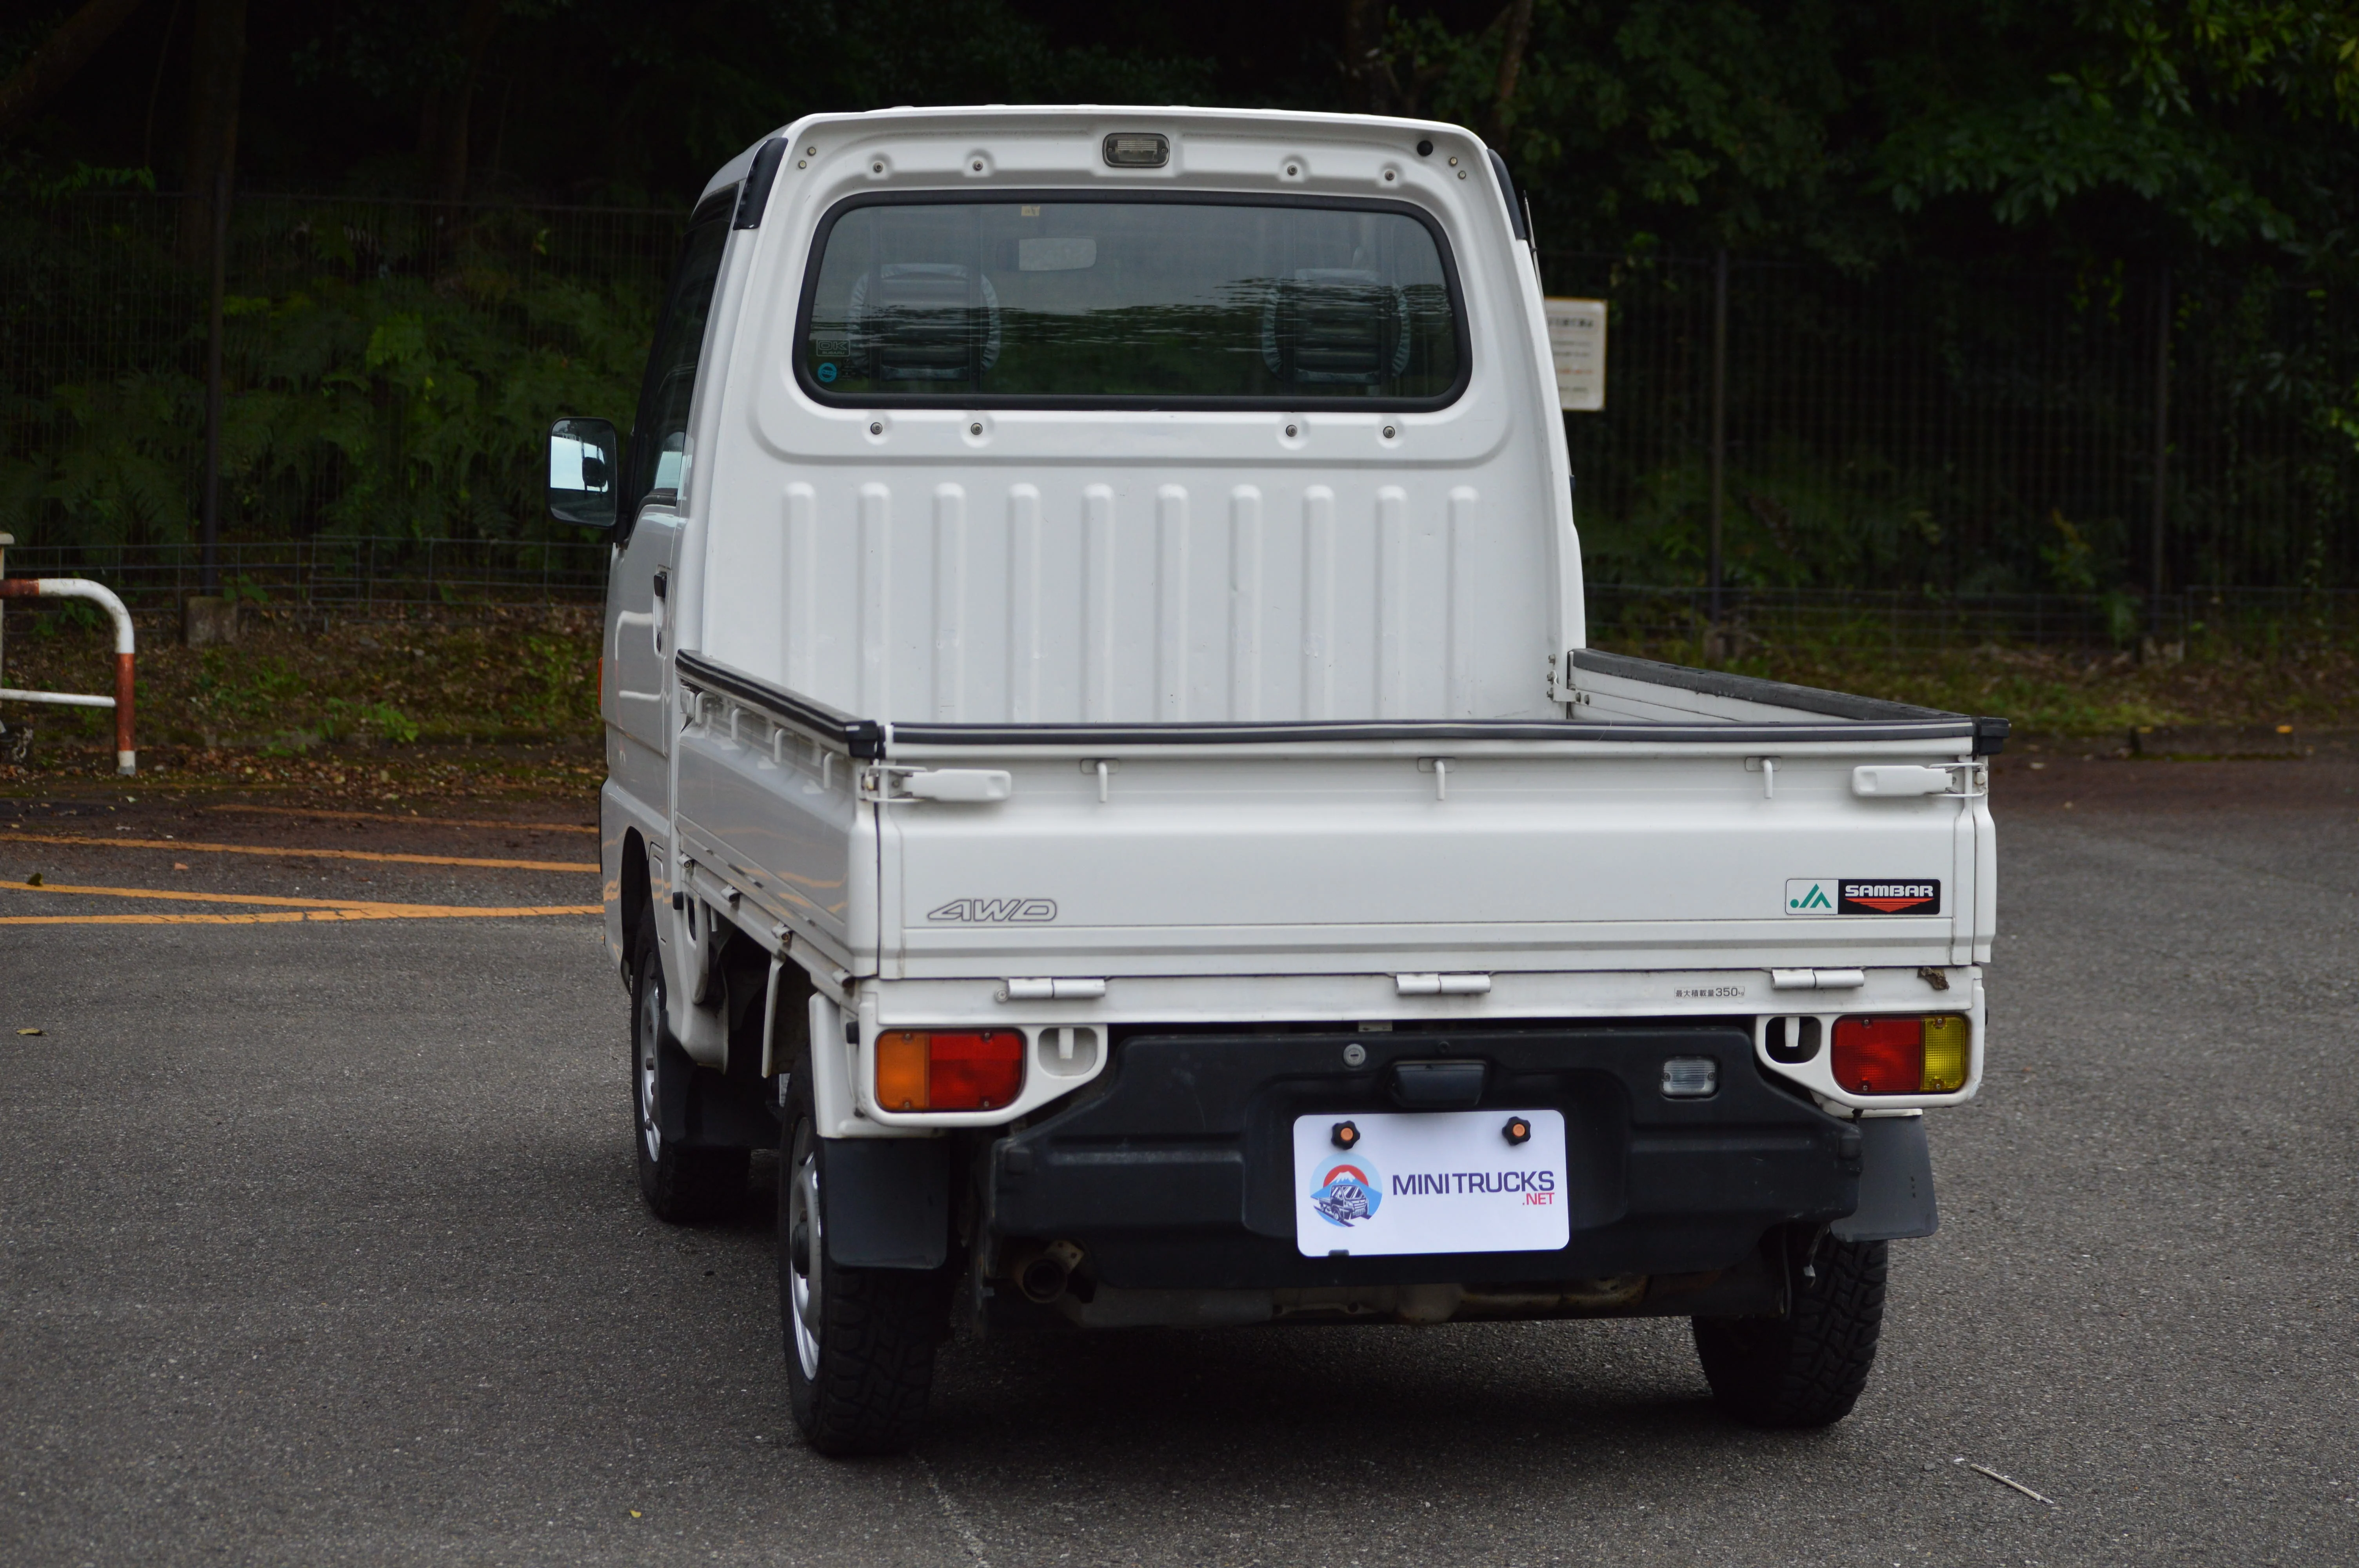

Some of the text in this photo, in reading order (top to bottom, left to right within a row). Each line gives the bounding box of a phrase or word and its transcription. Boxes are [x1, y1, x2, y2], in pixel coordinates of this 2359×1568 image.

[818, 341, 847, 350] OK
[1845, 885, 1933, 897] SAMBAR
[927, 899, 1057, 921] 4WD
[1393, 1171, 1554, 1195] MINITRUCKS
[1522, 1193, 1555, 1205] .NET
